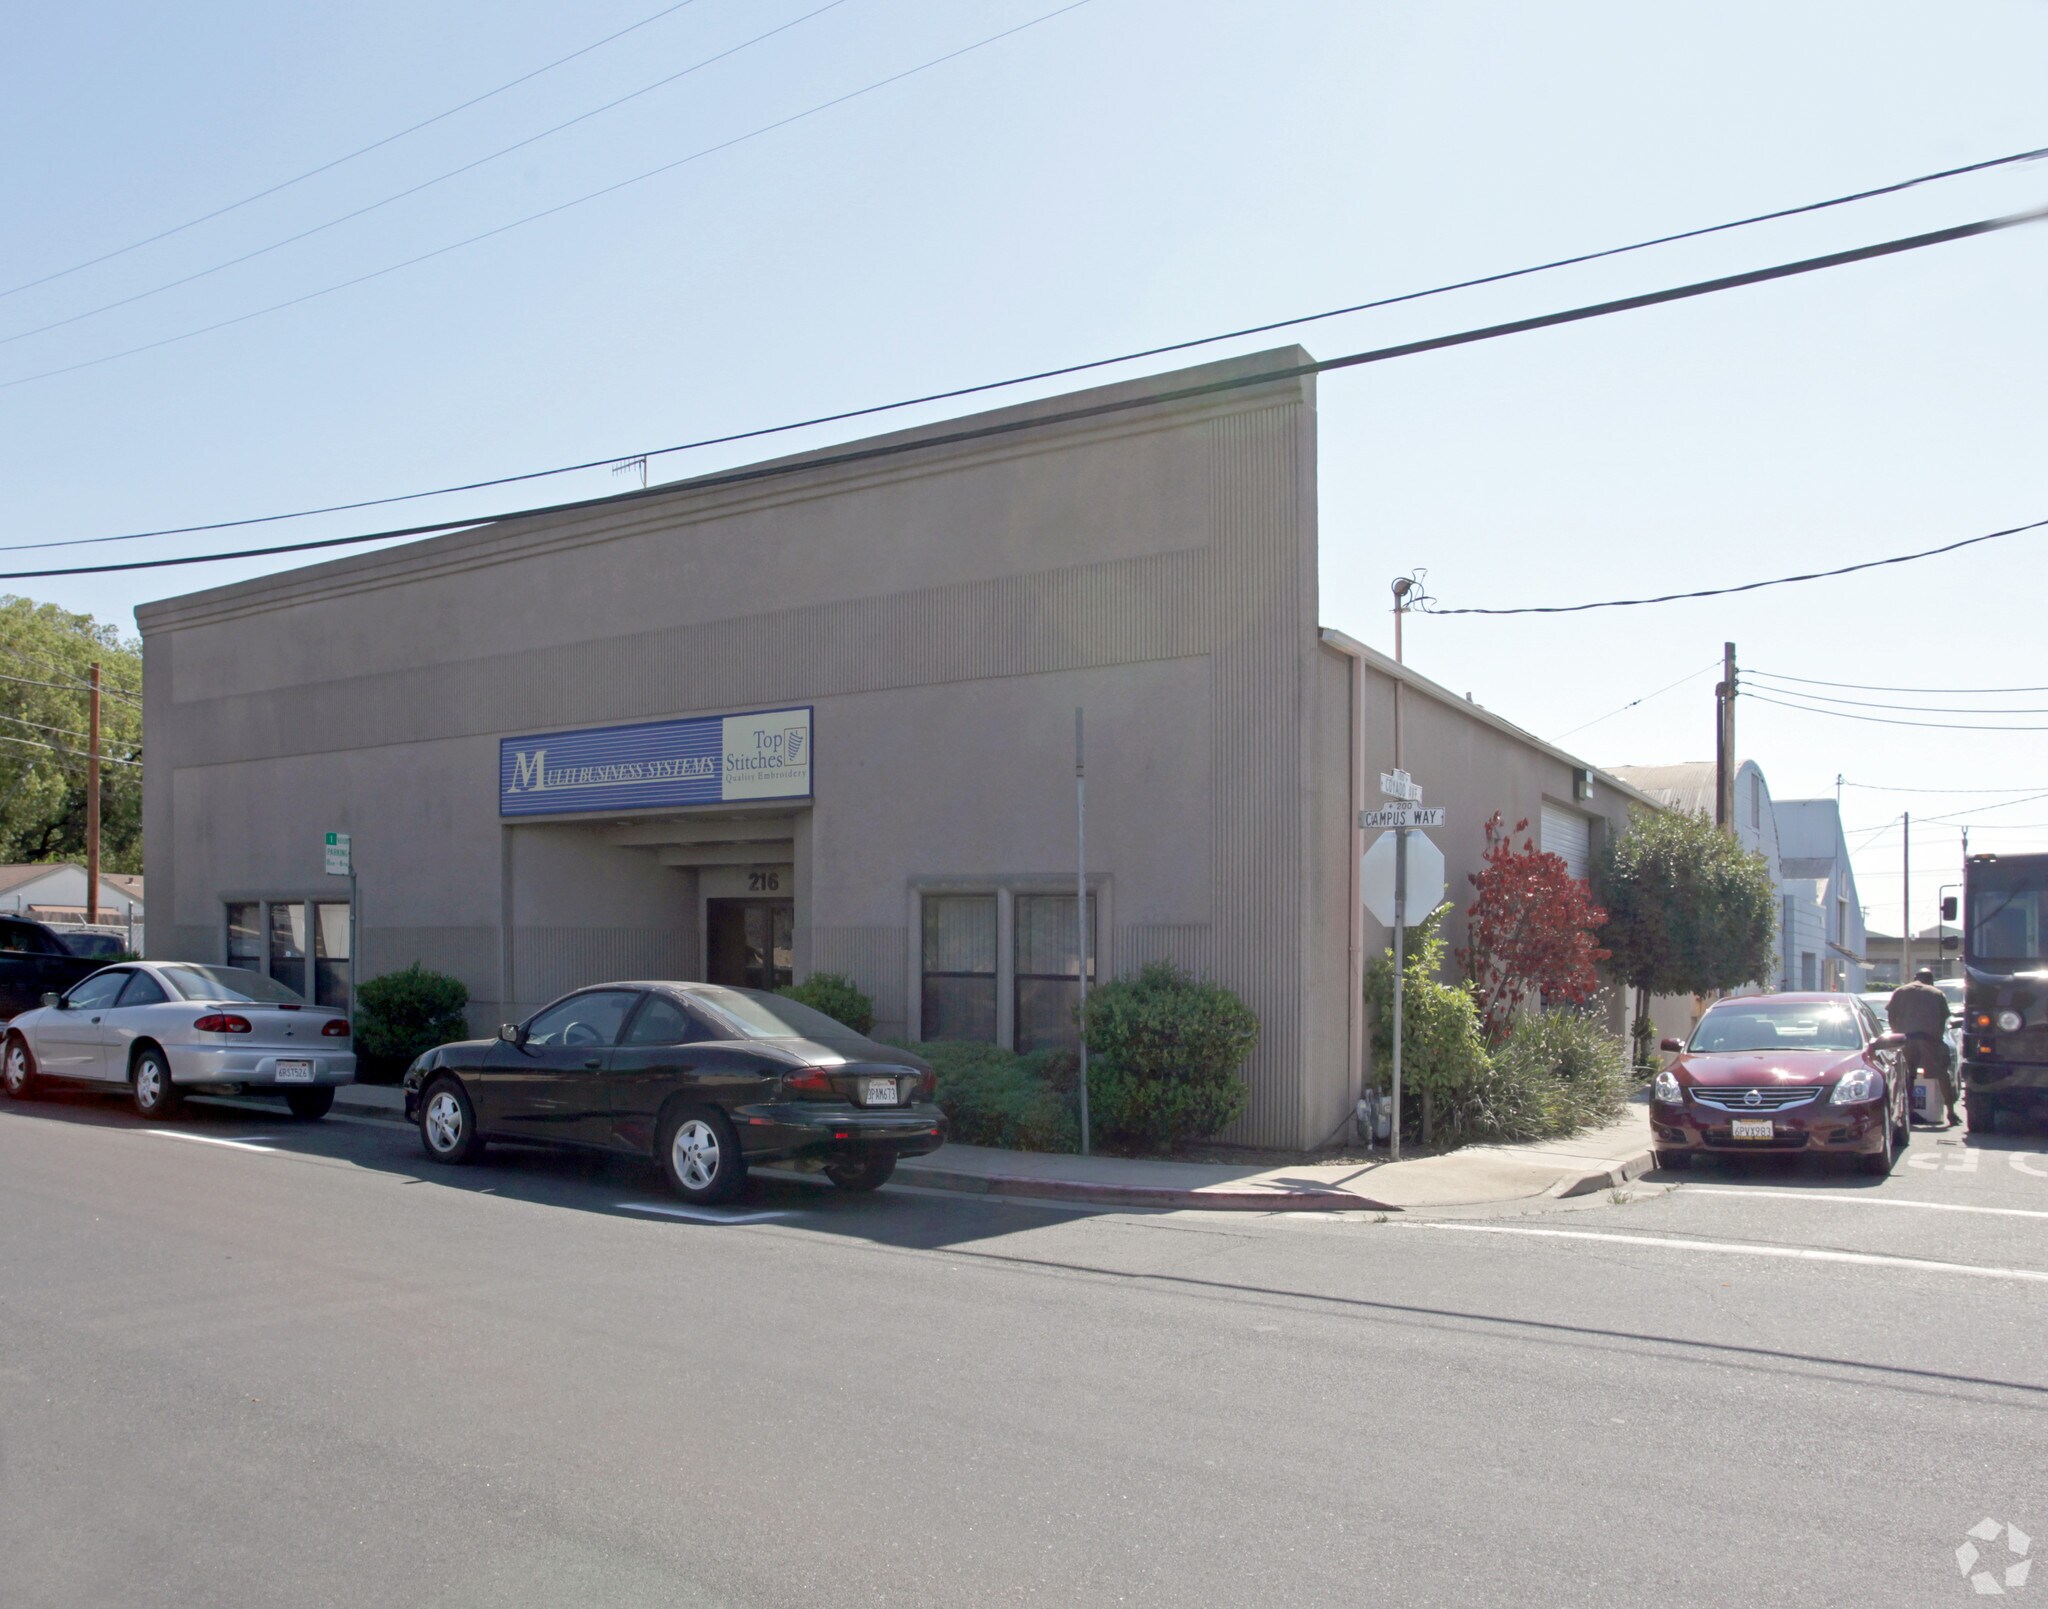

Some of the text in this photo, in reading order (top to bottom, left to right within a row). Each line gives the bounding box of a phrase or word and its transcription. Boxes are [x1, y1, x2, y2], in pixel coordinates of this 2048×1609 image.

[753, 730, 782, 752] Top
[647, 757, 715, 777] SYSTEMS
[726, 751, 782, 771] Stitches
[725, 769, 806, 784] Quality Embroidery
[1396, 802, 1412, 810] 200
[1365, 810, 1436, 826] CAMPUS WAY
[327, 848, 349, 857] PARKING
[749, 872, 779, 891] 216
[279, 1067, 307, 1078] 6RST526
[868, 1087, 896, 1101] 3PAM673
[1734, 1126, 1771, 1137] 6PVX983
